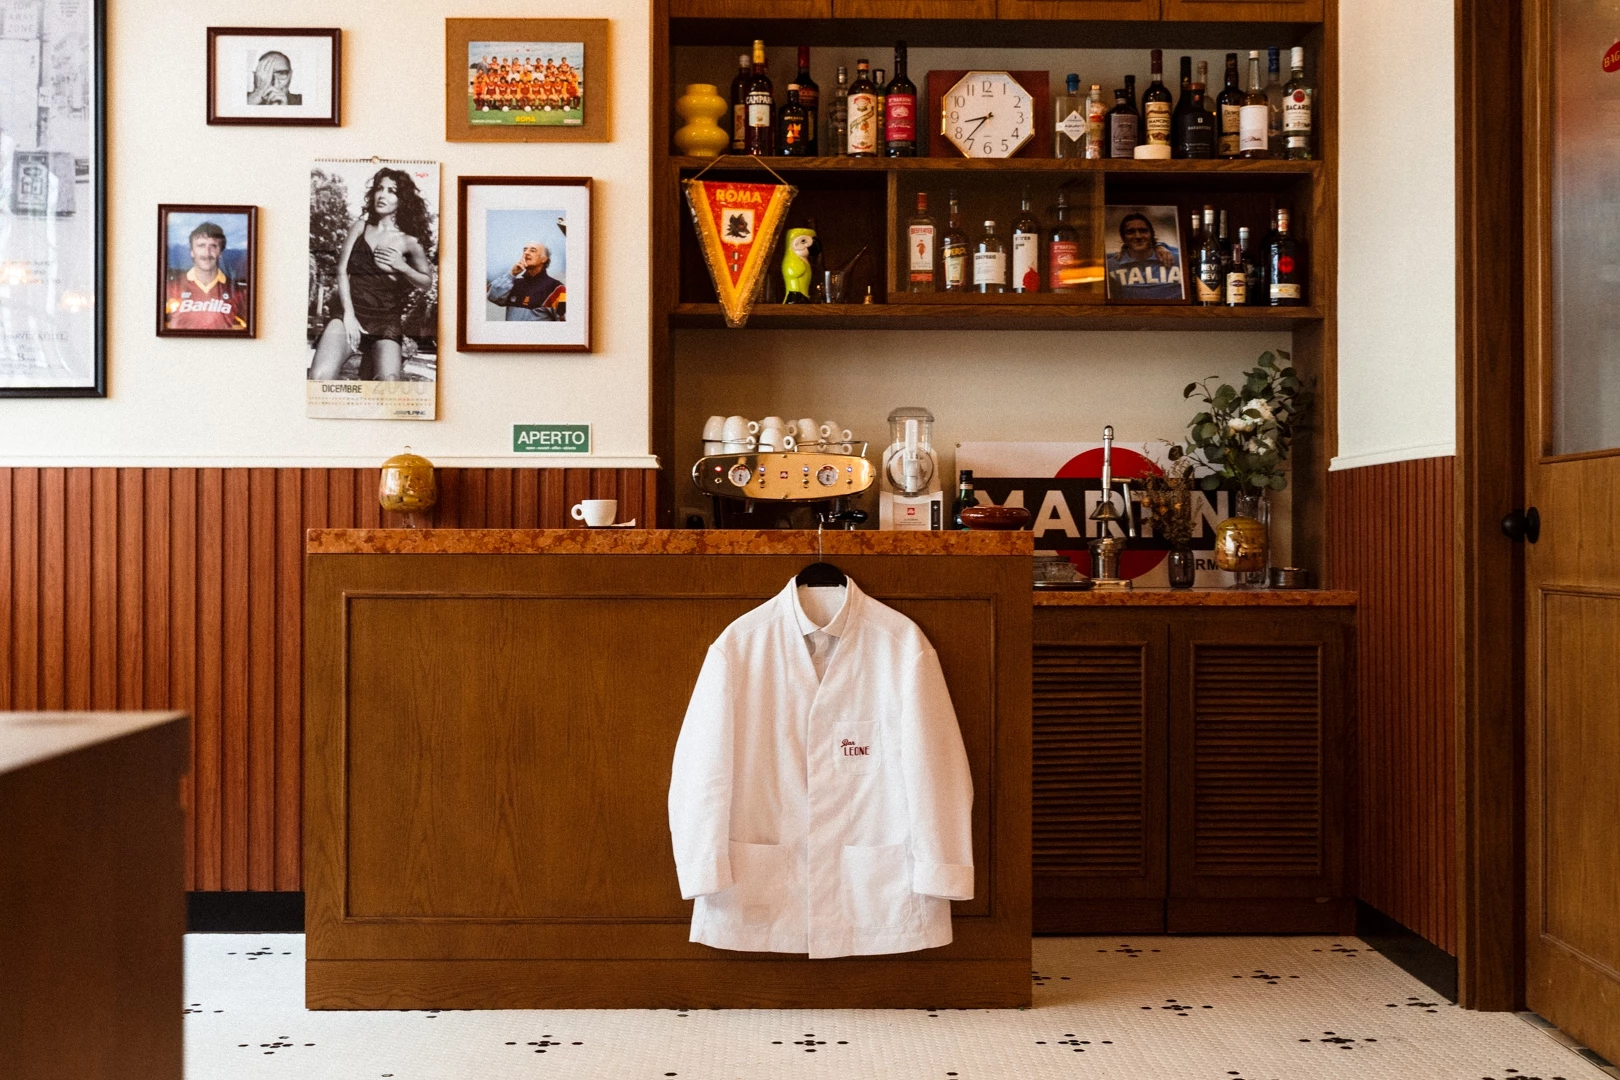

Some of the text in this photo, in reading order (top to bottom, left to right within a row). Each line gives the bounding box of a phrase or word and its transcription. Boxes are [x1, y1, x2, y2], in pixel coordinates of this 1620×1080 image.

[967, 84, 975, 96] 11
[982, 80, 992, 93] 12
[954, 95, 966, 108] 10
[1013, 96, 1022, 108] 2
[950, 111, 959, 123] 9
[1017, 112, 1024, 124] 3
[955, 127, 963, 140] 8
[1011, 127, 1019, 139] 4
[983, 142, 992, 154] 6
[1001, 139, 1009, 152] 5
[715, 188, 763, 204] ROMA
[179, 298, 232, 314] Barilla
[321, 384, 362, 393] DICEMBRE
[517, 431, 585, 445] APERTO
[973, 490, 1229, 538] ARTN
[843, 746, 870, 756] LEONE
